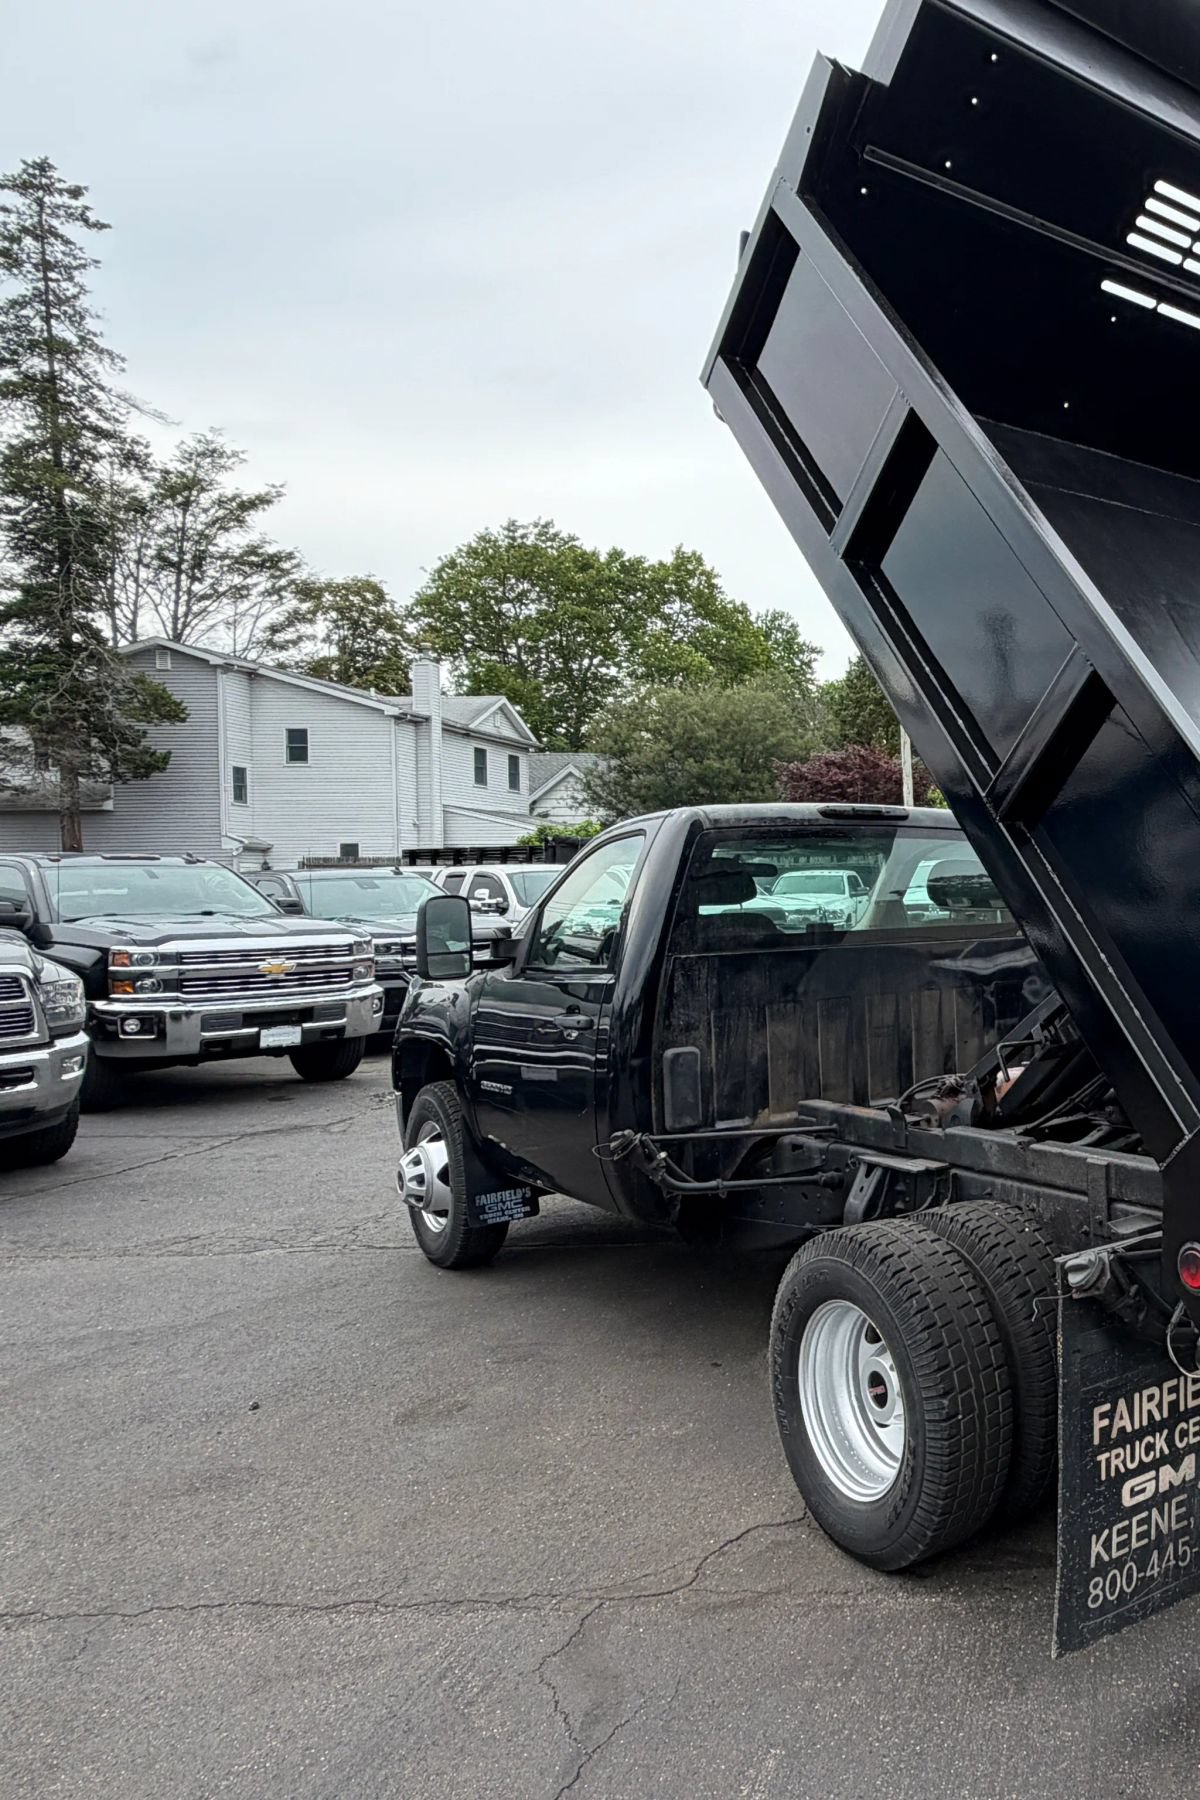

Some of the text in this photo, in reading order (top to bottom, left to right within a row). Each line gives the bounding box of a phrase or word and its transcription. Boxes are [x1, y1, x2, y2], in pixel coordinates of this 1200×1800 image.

[475, 1186, 531, 1206] FAIRFIELD'S
[485, 1199, 523, 1213] GMC
[1097, 1427, 1168, 1481] TRUCK
[1090, 1494, 1195, 1568] KEENE,
